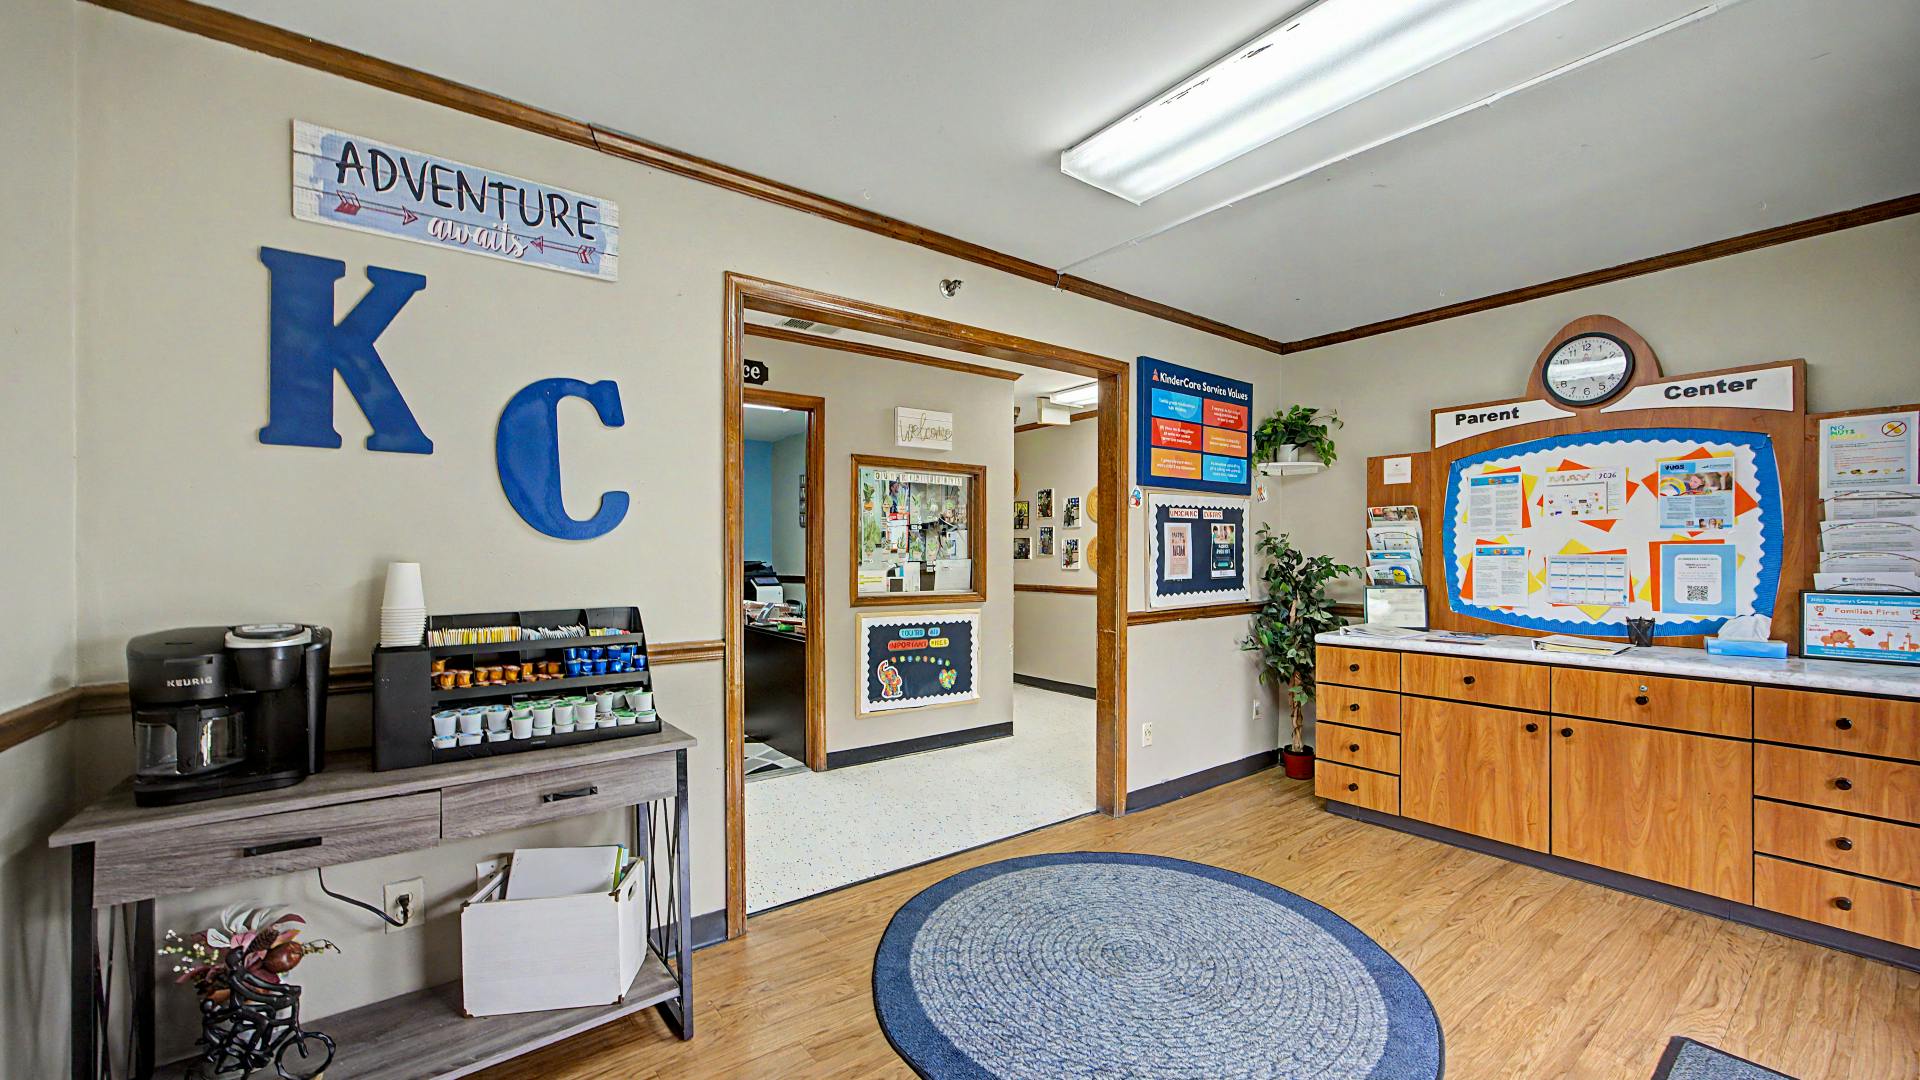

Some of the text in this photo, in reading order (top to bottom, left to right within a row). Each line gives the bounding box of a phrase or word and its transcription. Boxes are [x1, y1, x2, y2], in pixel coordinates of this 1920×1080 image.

[336, 140, 598, 242] ADVENTURE
[427, 214, 529, 259] awaits
[258, 245, 434, 455] K
[1582, 343, 1592, 351] 12
[1569, 349, 1577, 357] 11
[1607, 373, 1615, 381] 4
[1159, 372, 1249, 401] KinderCare Service Values
[1570, 386, 1577, 395] 7
[1598, 382, 1606, 390] 5
[1662, 375, 1759, 400] Center
[1583, 387, 1591, 396] 6
[1454, 406, 1520, 426] Parent
[495, 376, 631, 541] C
[1834, 607, 1900, 616] Families First
[889, 640, 928, 649] IMPORTANT
[166, 676, 213, 687] KEURIG
